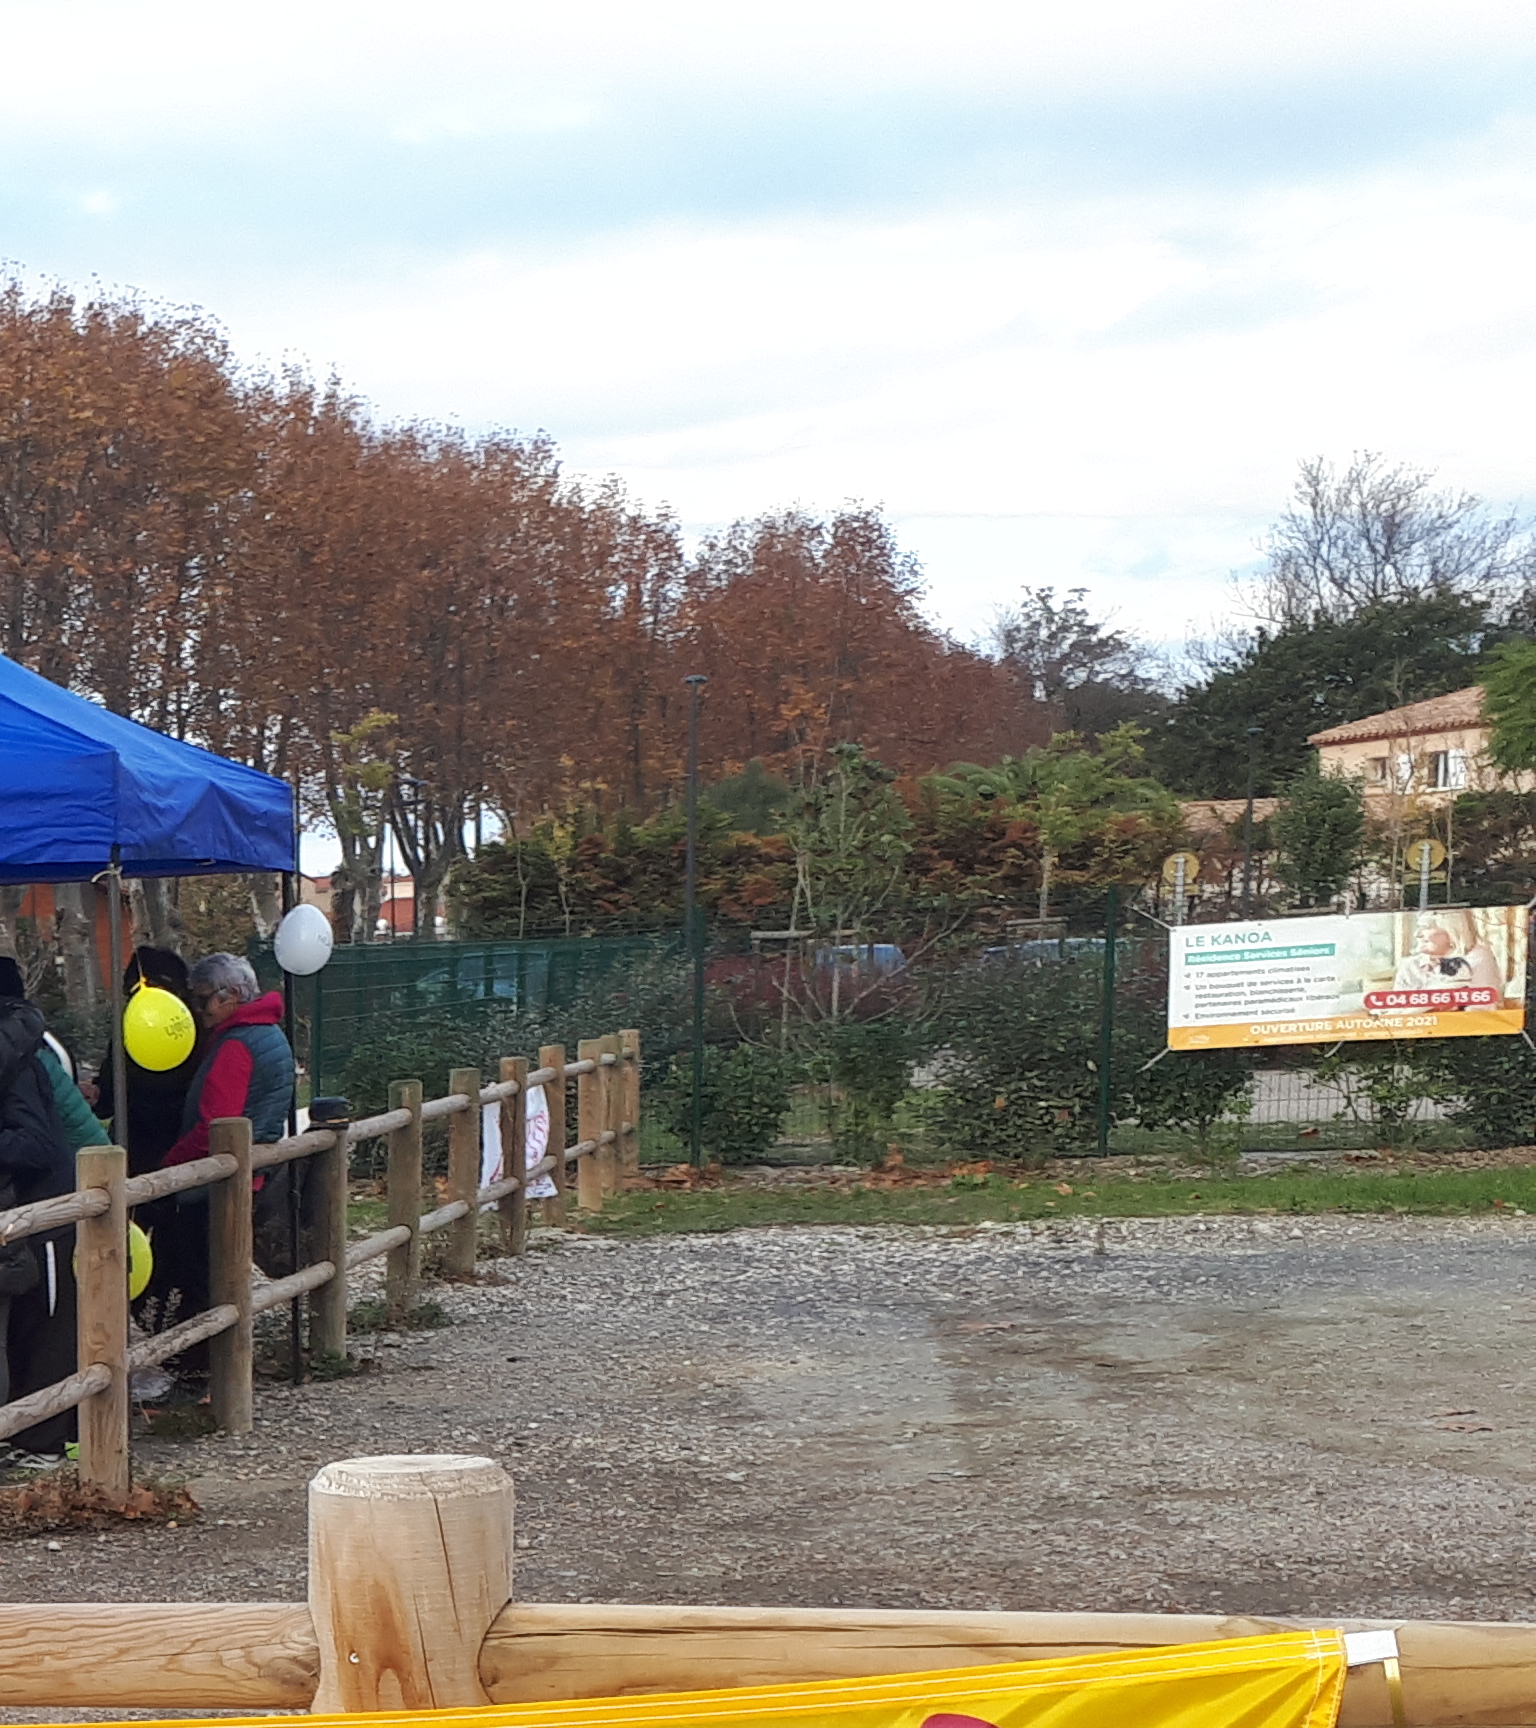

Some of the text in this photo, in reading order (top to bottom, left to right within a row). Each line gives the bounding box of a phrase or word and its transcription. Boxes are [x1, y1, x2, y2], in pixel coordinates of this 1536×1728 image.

[1185, 931, 1273, 948] LE KANOA
[1243, 950, 1287, 960] Services
[1386, 991, 1491, 1006] 04 68 66 13 66
[1249, 1021, 1332, 1035] OUVERTURE
[1406, 1015, 1438, 1028] 2021
